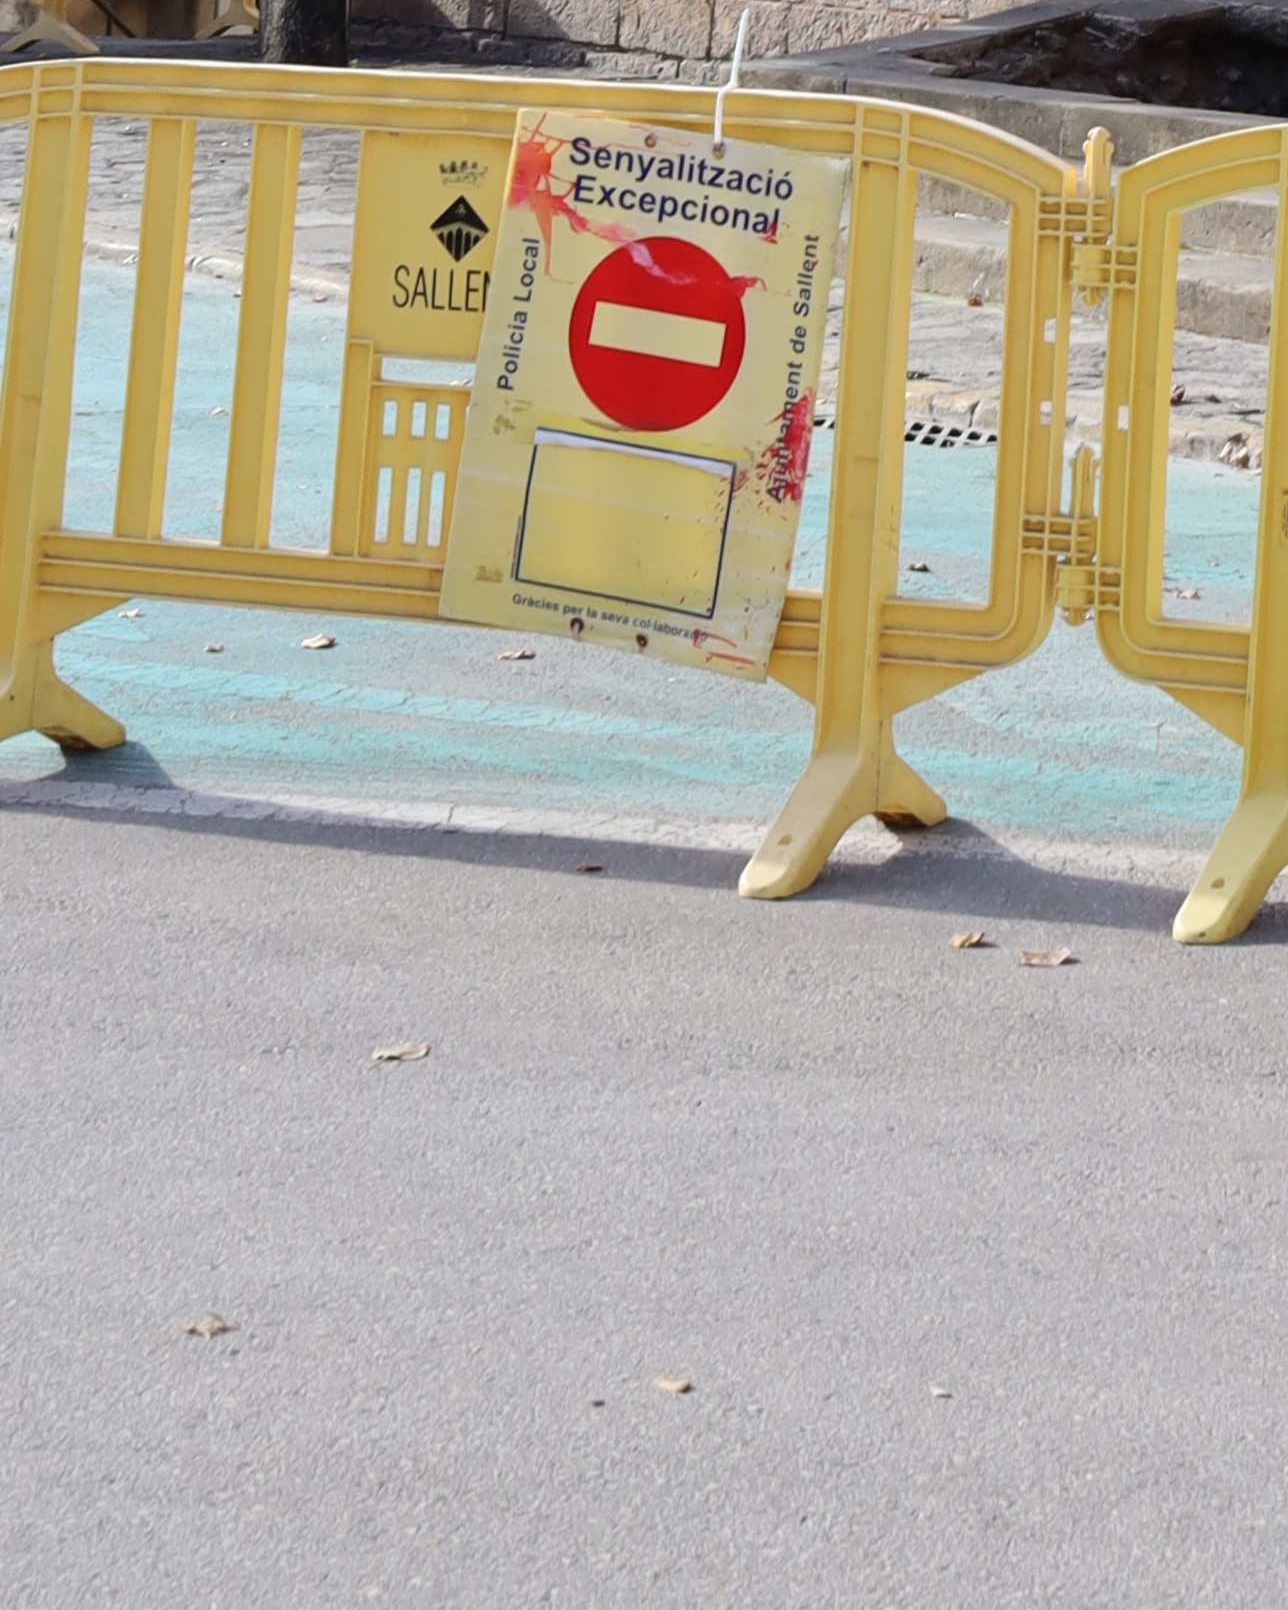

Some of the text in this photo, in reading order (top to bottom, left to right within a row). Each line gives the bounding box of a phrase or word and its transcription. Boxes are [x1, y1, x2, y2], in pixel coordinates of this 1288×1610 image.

[569, 137, 794, 201] Senyalització
[573, 174, 780, 237] Excepcional
[793, 234, 820, 318] Sallent
[497, 238, 540, 391] Policia Local
[790, 325, 807, 354] de
[512, 593, 559, 612] Gràcies
[563, 605, 584, 617] per
[587, 607, 597, 619] la
[601, 612, 630, 624] seva
